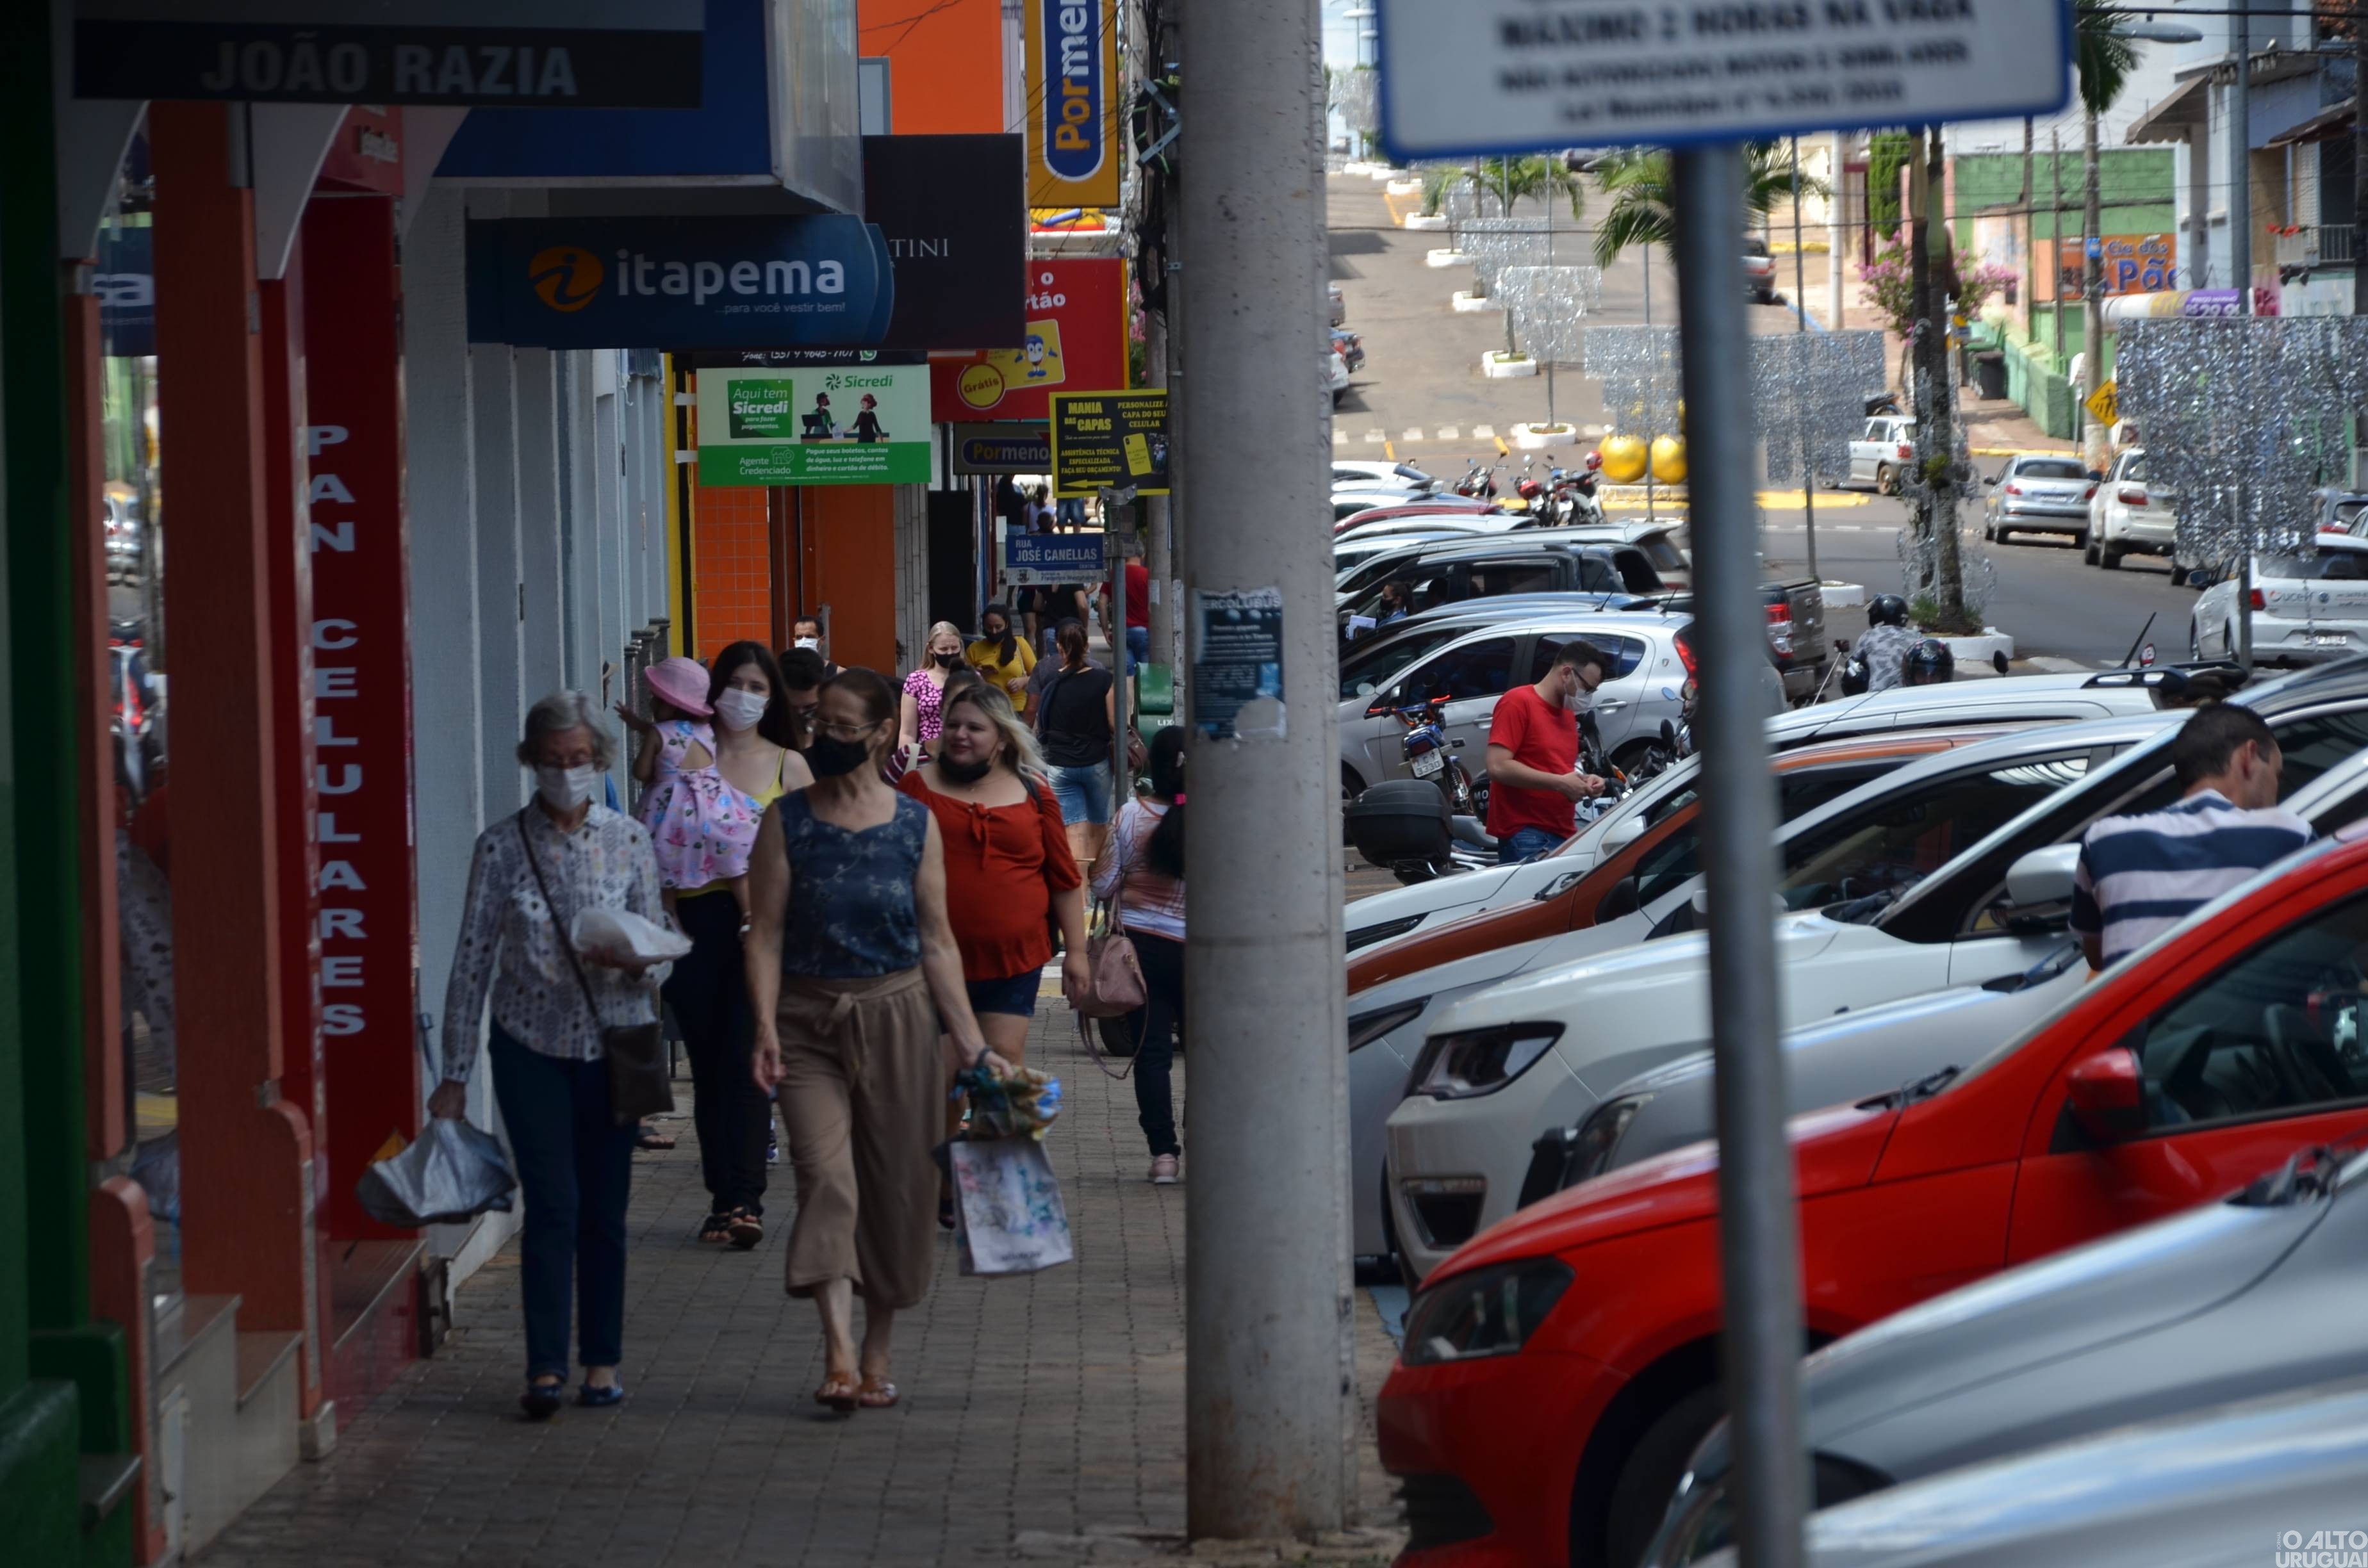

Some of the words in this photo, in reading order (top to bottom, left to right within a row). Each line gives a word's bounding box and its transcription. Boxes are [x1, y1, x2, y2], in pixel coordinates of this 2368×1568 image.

[201, 30, 370, 94] JOÃO
[393, 44, 579, 95] RAZIA
[1055, 0, 1090, 150] Porme
[2108, 240, 2134, 255] Cia
[616, 249, 845, 306] itapema
[2117, 257, 2178, 292] Pãe
[754, 301, 781, 313] você
[784, 302, 814, 313] vestir
[818, 301, 845, 313] bem!
[844, 374, 893, 388] Sicredi
[964, 377, 999, 394] Grátis
[733, 388, 761, 400] Aqui
[764, 389, 788, 398] tem
[733, 400, 789, 414] Sicredi
[1068, 402, 1103, 414] MANIA
[1117, 400, 1164, 409] PERSONALIZE
[1077, 418, 1112, 431] CAPAS
[1128, 420, 1160, 428] CELULAR
[973, 443, 1050, 461] Pormeno
[1061, 448, 1096, 457] ASSISTÊNCIA
[1096, 447, 1120, 455] TÉCNICA
[739, 457, 769, 467] Agente
[739, 466, 791, 475] Credenciado
[1061, 468, 1074, 476] FAÇA
[309, 425, 358, 553] PAN
[1015, 539, 1033, 548] RUA
[1015, 546, 1041, 562] JOSÉ
[1044, 548, 1098, 562] CANELLAS
[312, 617, 368, 1036] CELULARES
